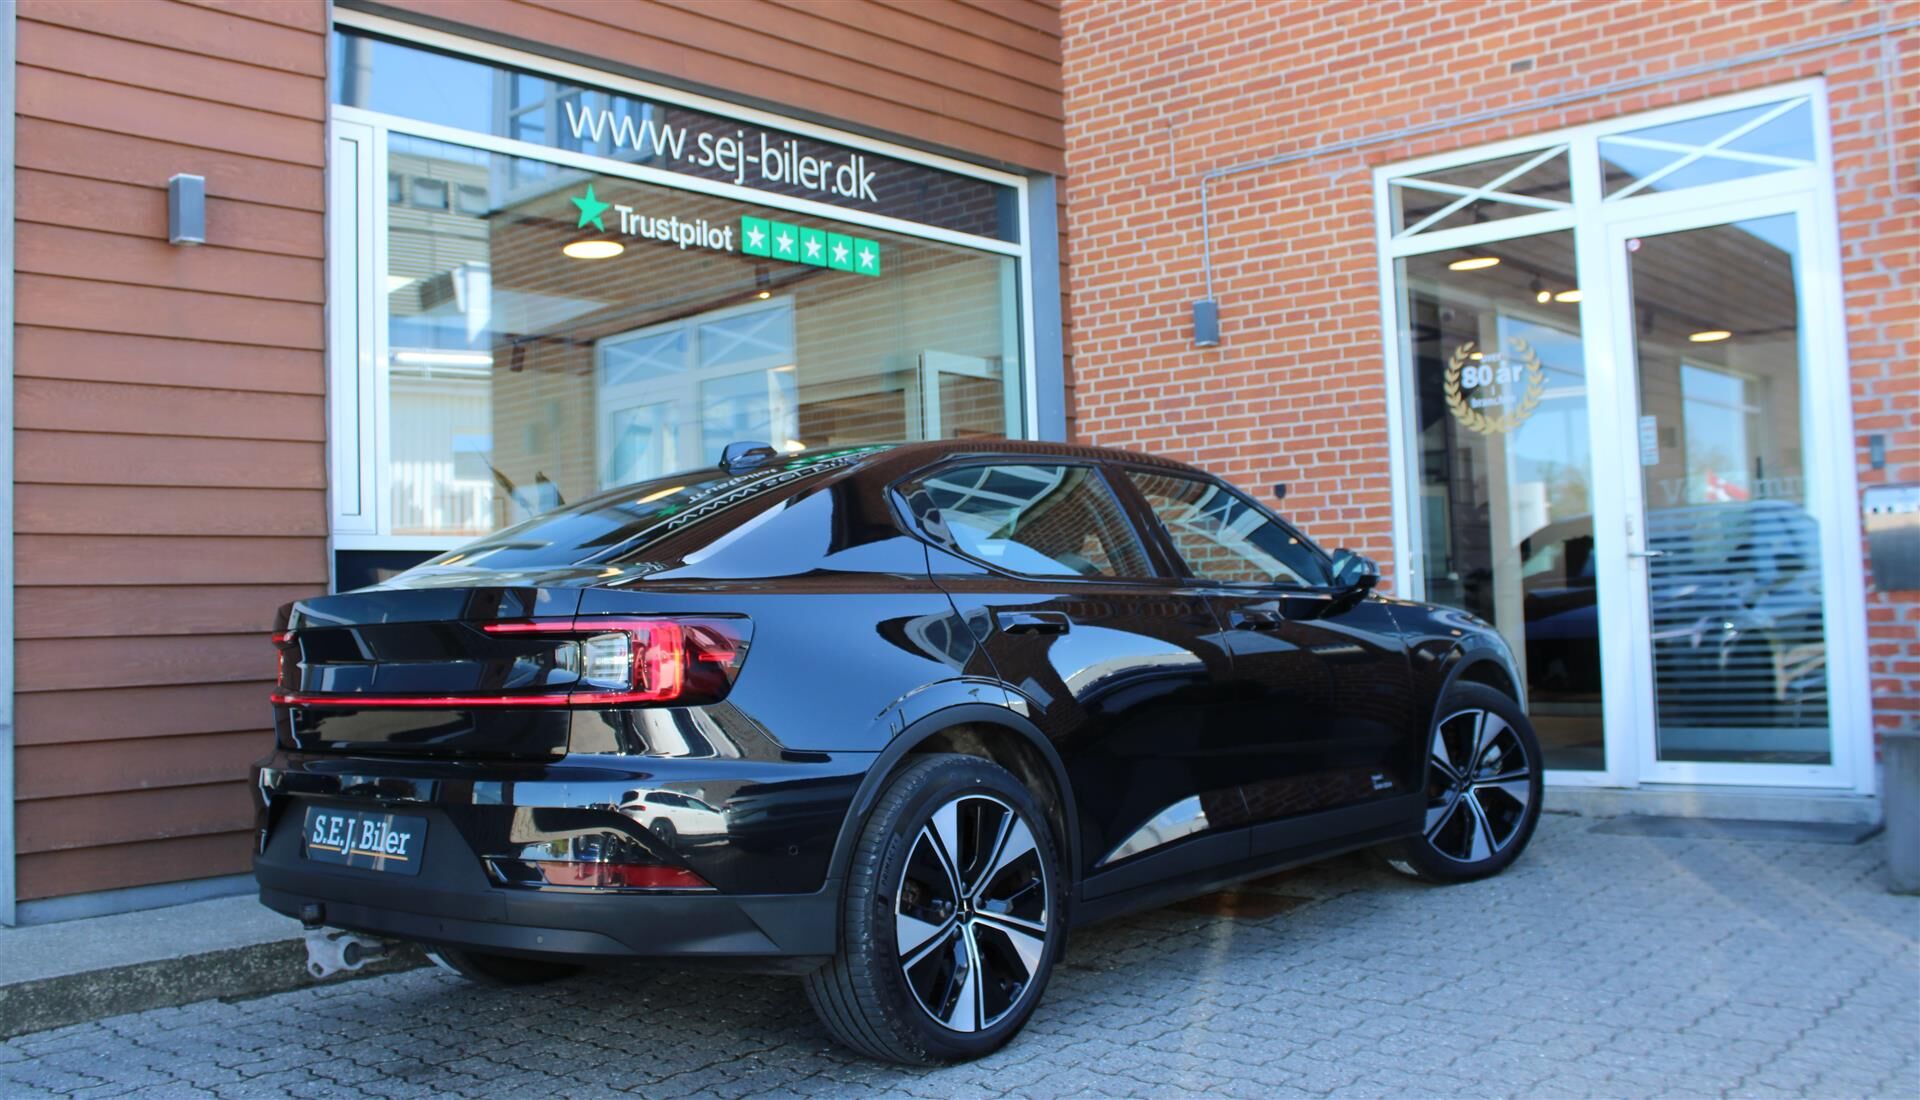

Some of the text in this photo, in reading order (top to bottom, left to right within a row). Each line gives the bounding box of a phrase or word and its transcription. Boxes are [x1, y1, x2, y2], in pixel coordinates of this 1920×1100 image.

[565, 102, 877, 202] www.sej-biler.dk
[614, 204, 733, 251] Trustpilot
[1461, 365, 1493, 389] 80
[312, 815, 411, 855] S.E.J. Biler
